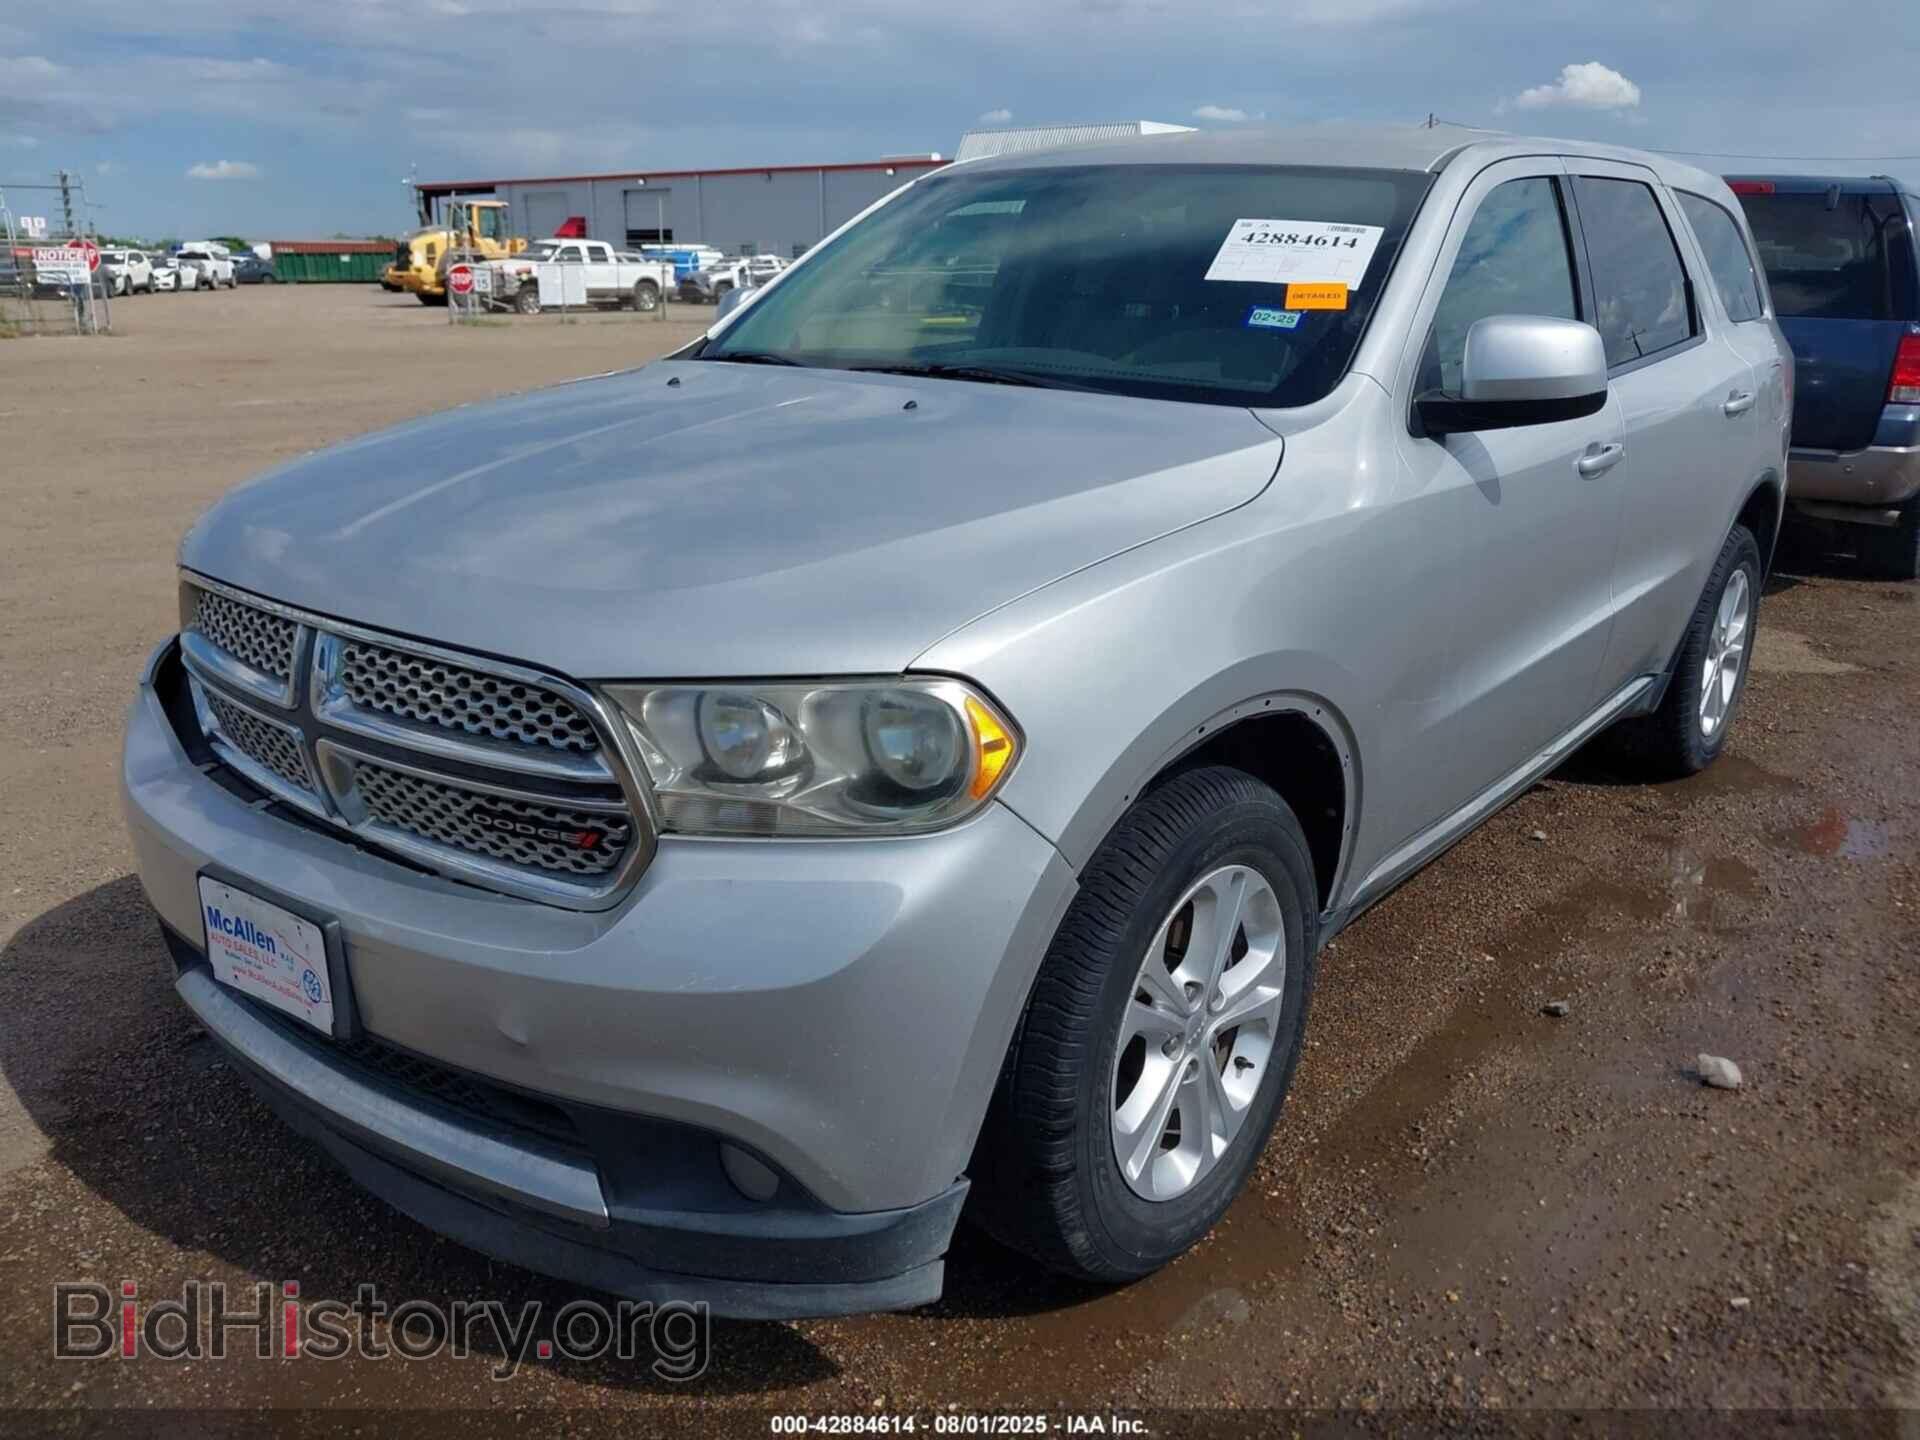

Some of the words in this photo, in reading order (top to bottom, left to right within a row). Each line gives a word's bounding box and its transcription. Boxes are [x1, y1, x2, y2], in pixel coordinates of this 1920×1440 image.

[1241, 232, 1358, 249] 42884614
[38, 249, 84, 261] NOTICE
[450, 273, 472, 284] STOP
[473, 813, 580, 844] DODGE
[207, 905, 276, 955] McAllen
[210, 932, 232, 949] AUTO
